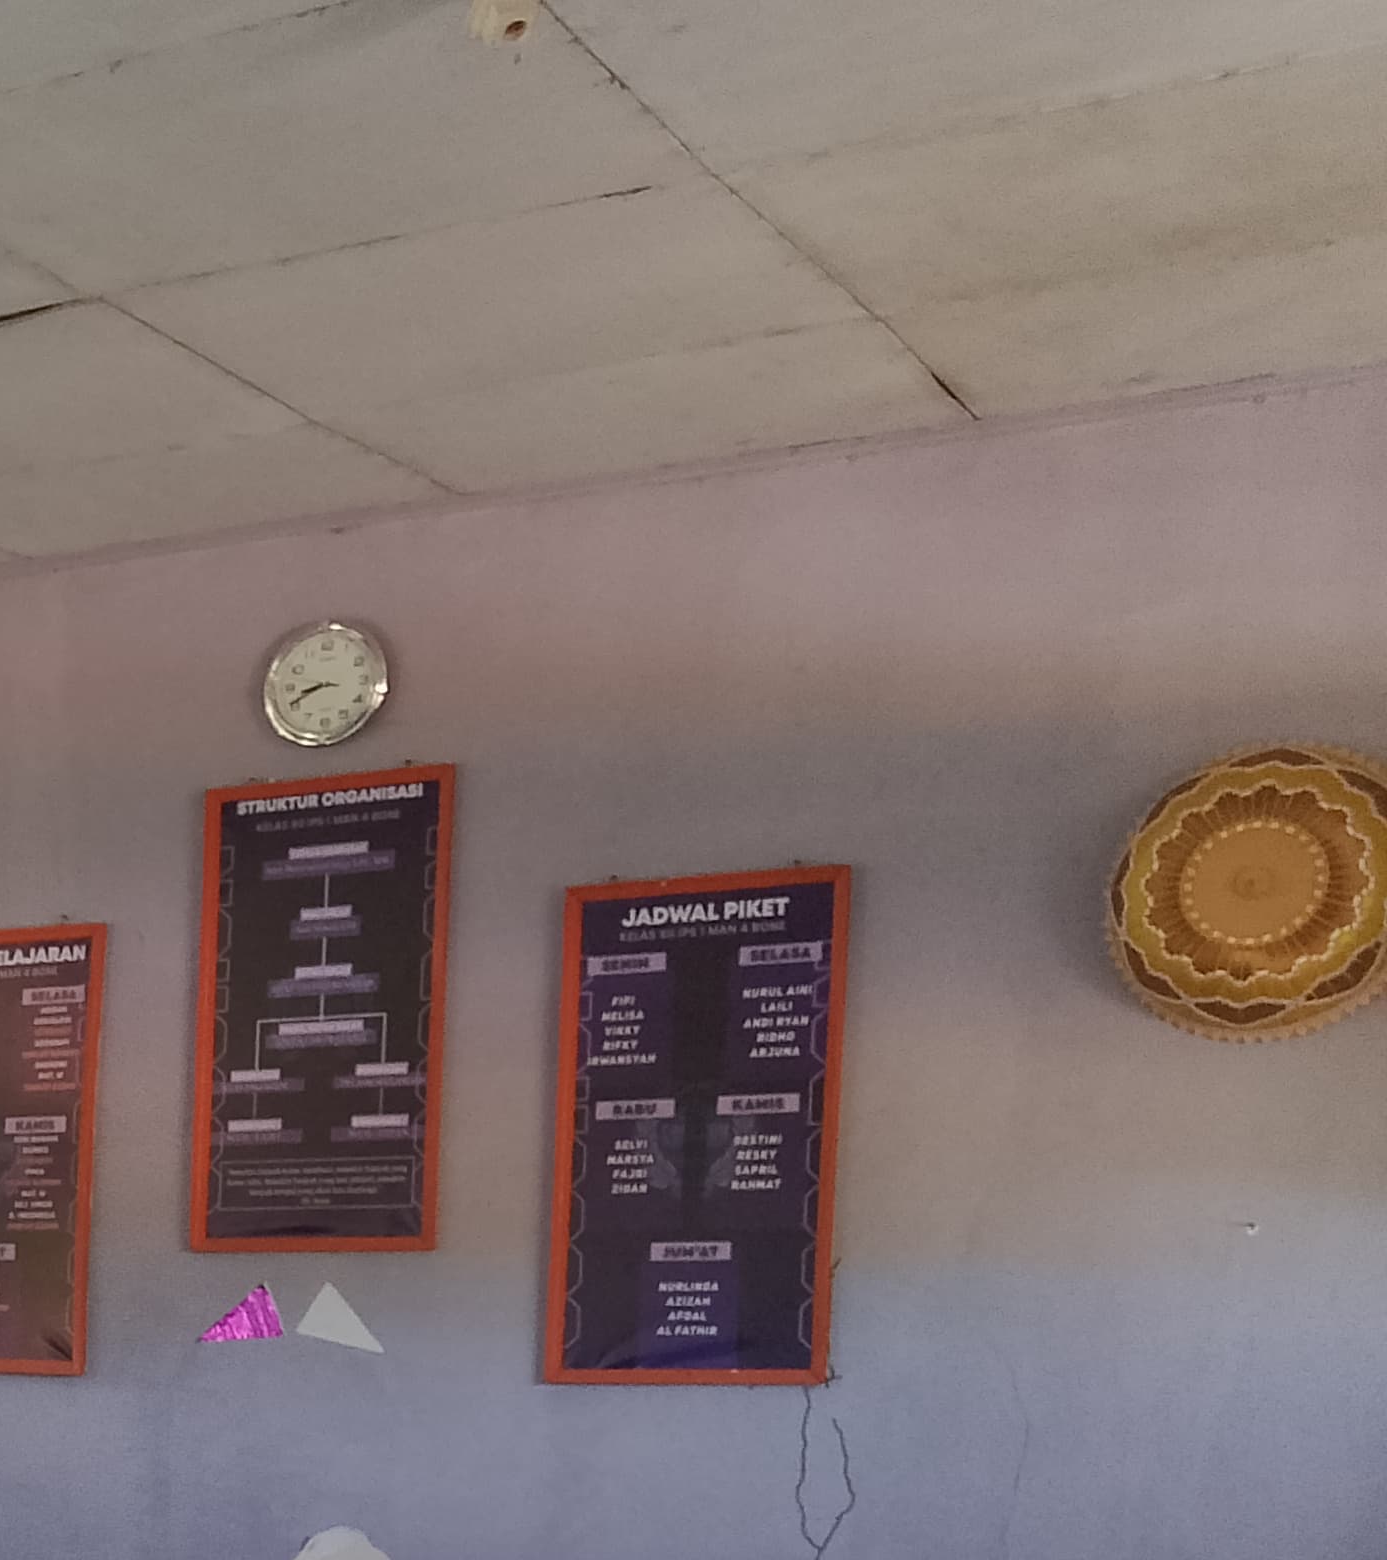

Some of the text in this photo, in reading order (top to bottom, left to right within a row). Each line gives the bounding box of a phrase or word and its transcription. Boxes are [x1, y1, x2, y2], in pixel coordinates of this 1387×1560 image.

[237, 782, 424, 816] STRUKTUR ORGANISASI
[621, 897, 790, 928] JADWAL PIKET
[750, 947, 812, 962] SELASA
